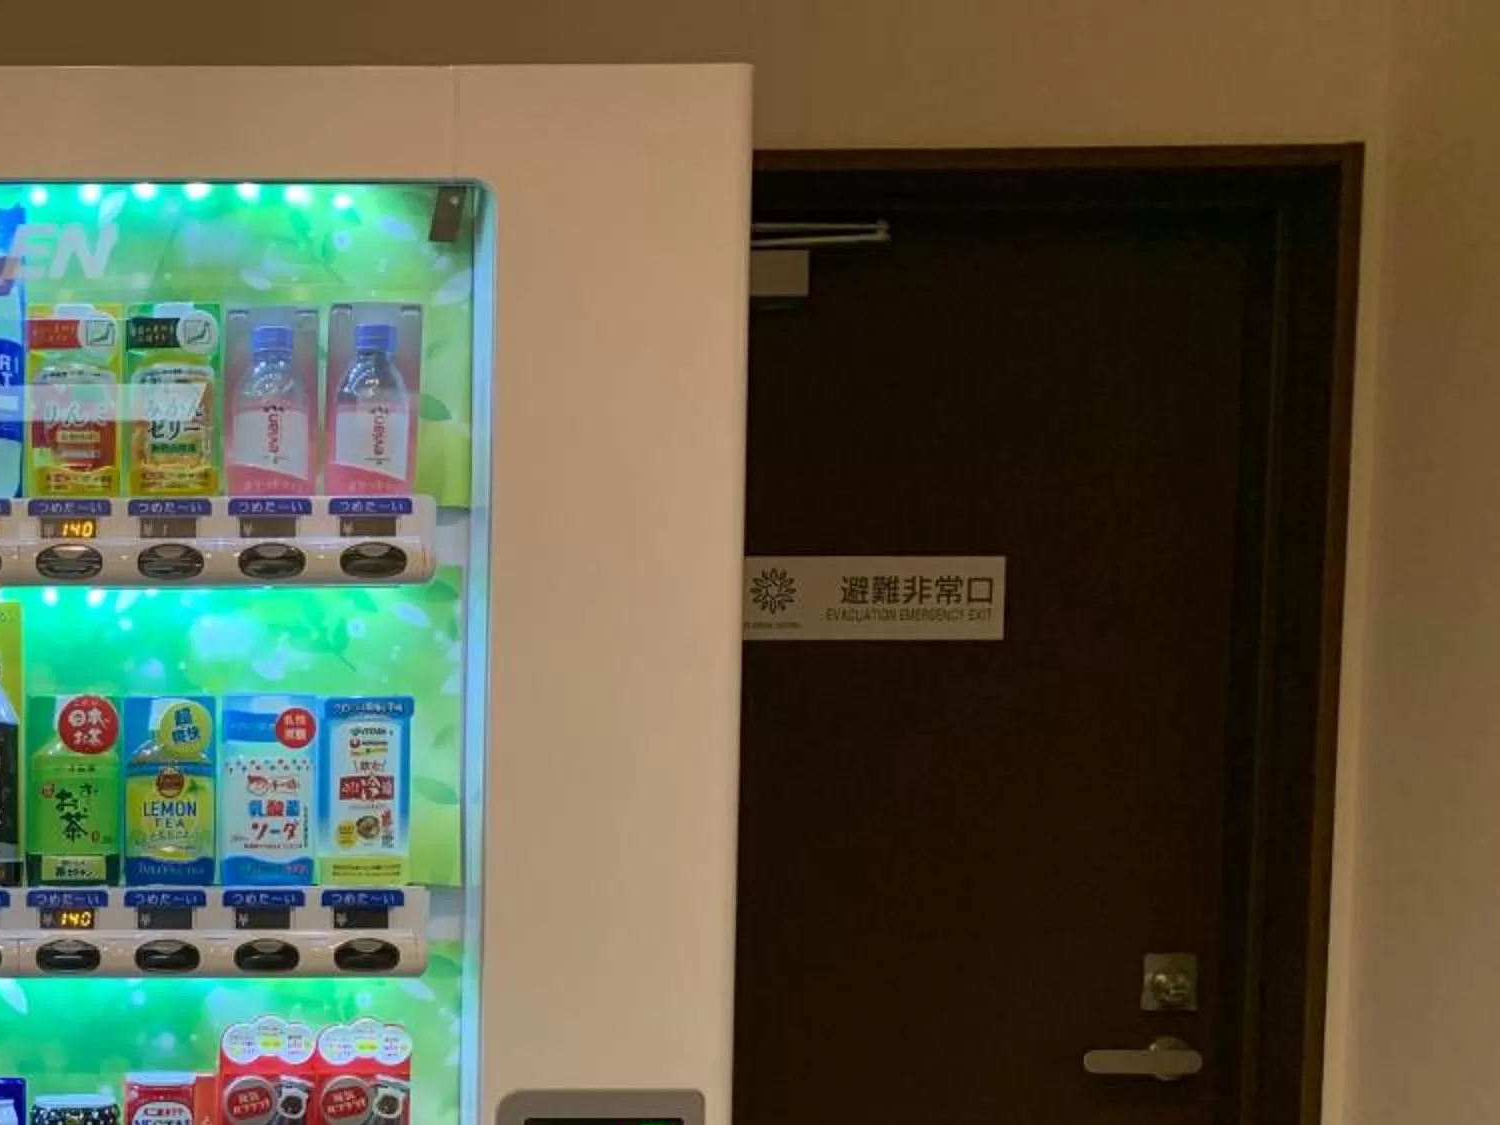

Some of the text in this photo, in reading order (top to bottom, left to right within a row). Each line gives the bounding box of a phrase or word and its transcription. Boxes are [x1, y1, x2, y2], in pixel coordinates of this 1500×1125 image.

[150, 420, 202, 441] ゼリー
[62, 520, 93, 537] 140
[840, 575, 994, 605] 避難非常口
[826, 608, 992, 621] EVACUATION EMERGENCY EXIT
[55, 788, 90, 842] お茶
[142, 801, 198, 818] LEMON
[154, 819, 186, 829] TEA
[251, 819, 300, 841] ソーダ
[59, 911, 91, 927] 140
